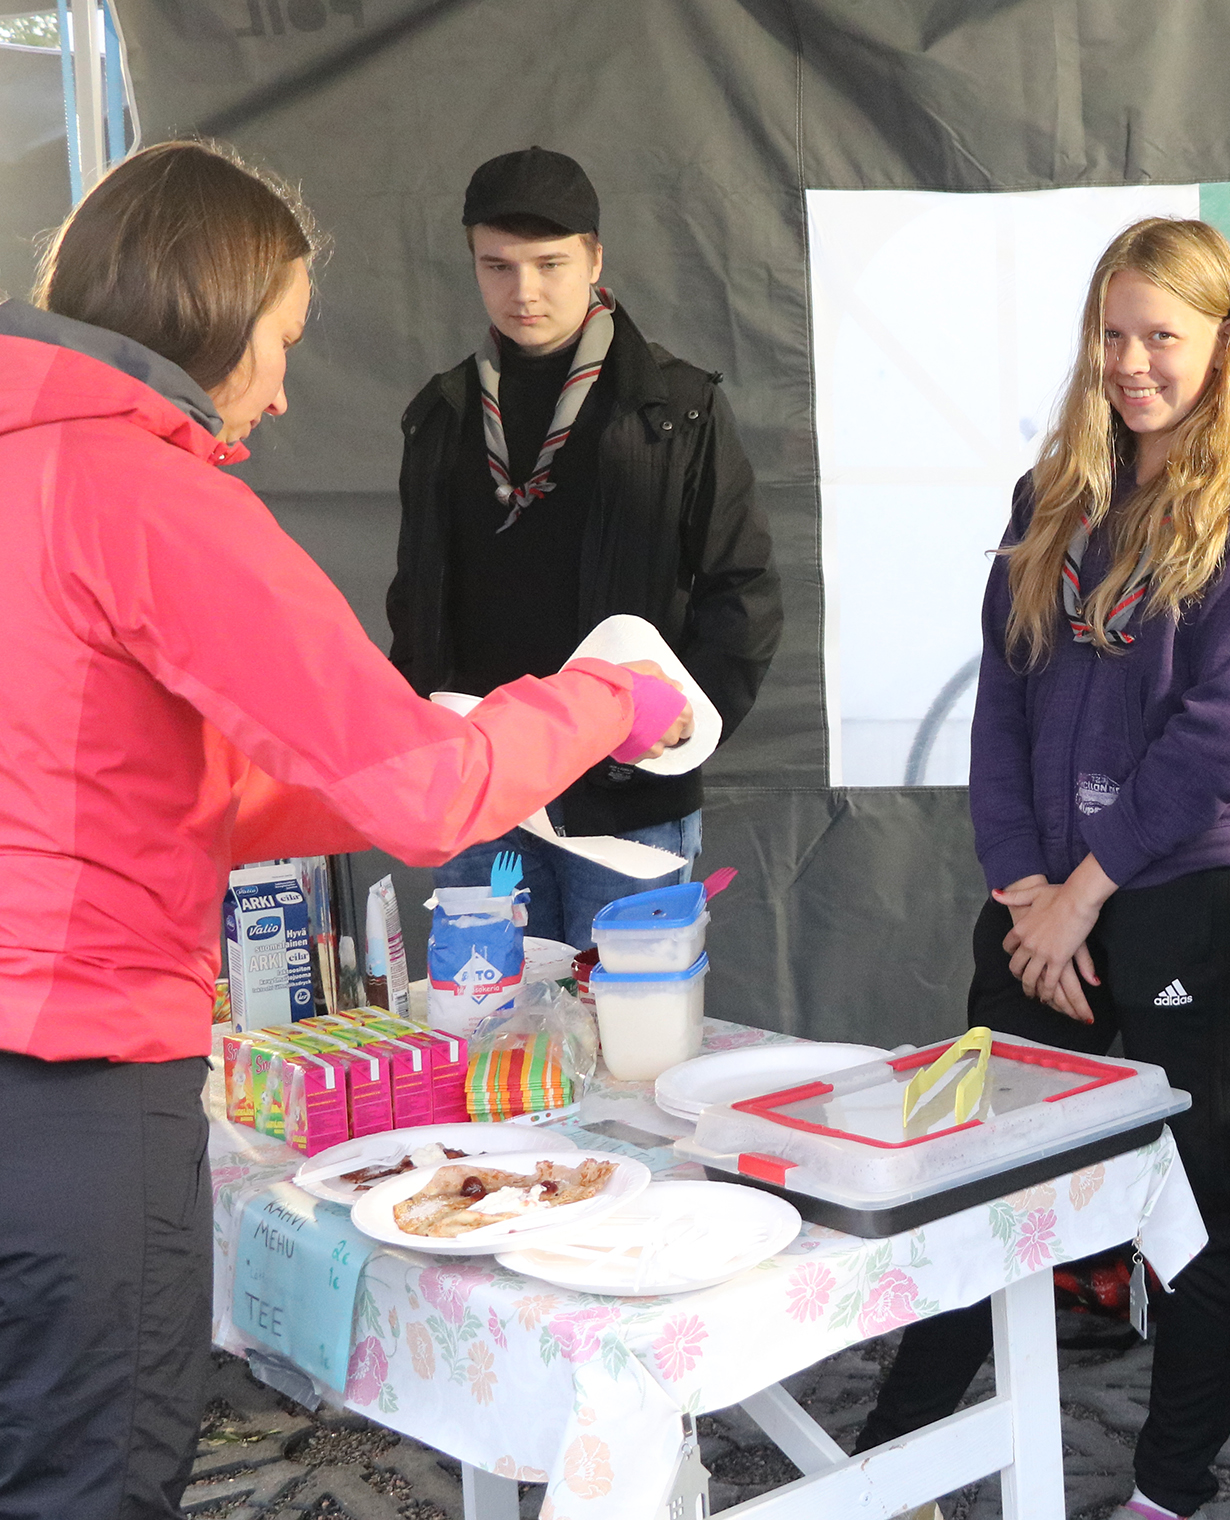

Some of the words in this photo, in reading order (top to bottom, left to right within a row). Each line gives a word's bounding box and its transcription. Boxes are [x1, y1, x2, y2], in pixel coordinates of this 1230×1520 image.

[242, 895, 276, 911] ARKI
[249, 923, 280, 937] Valio
[286, 928, 307, 939] Hyvä
[254, 938, 309, 953] suomalainen
[249, 951, 284, 973] ARKI
[1153, 994, 1194, 1006] adidas
[254, 1218, 295, 1259] MEHU
[244, 1291, 284, 1338] TEE
